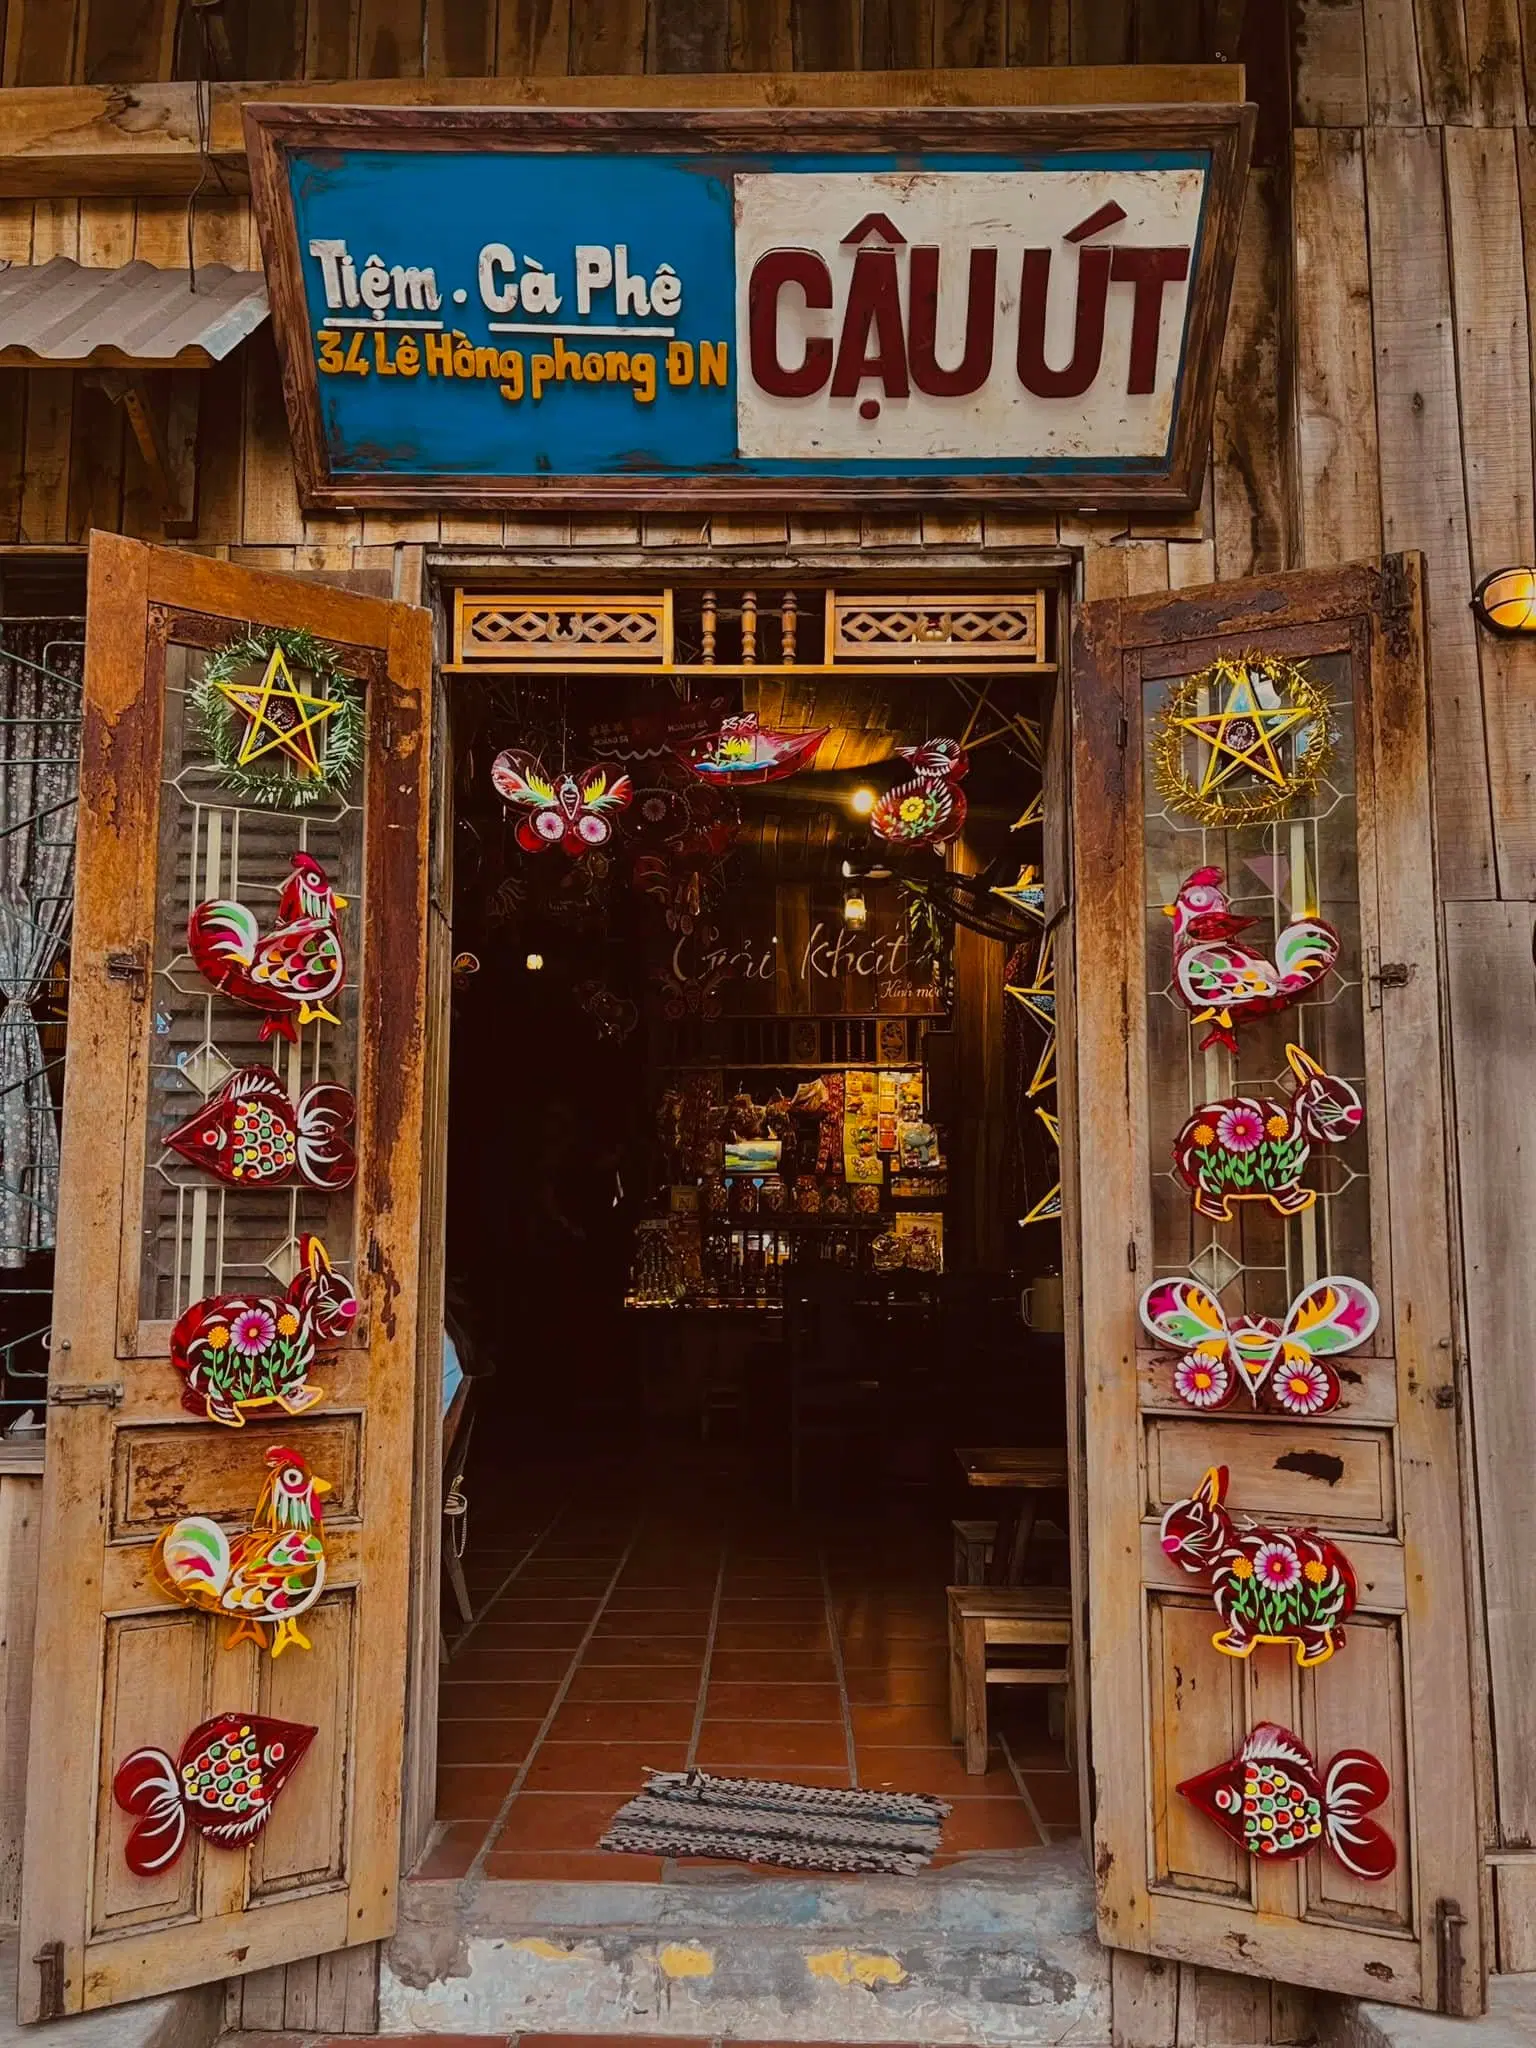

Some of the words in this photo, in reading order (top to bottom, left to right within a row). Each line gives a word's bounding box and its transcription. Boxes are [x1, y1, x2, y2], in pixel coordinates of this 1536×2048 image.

[309, 239, 442, 320] Tiệm
[479, 243, 563, 314] Cà
[575, 244, 682, 316] Phê
[749, 212, 998, 420] CẬU
[1016, 200, 1191, 399] ÚT
[317, 330, 370, 376] 34
[374, 331, 421, 376] Lê
[425, 328, 524, 400] Hồng
[531, 337, 656, 402] phong
